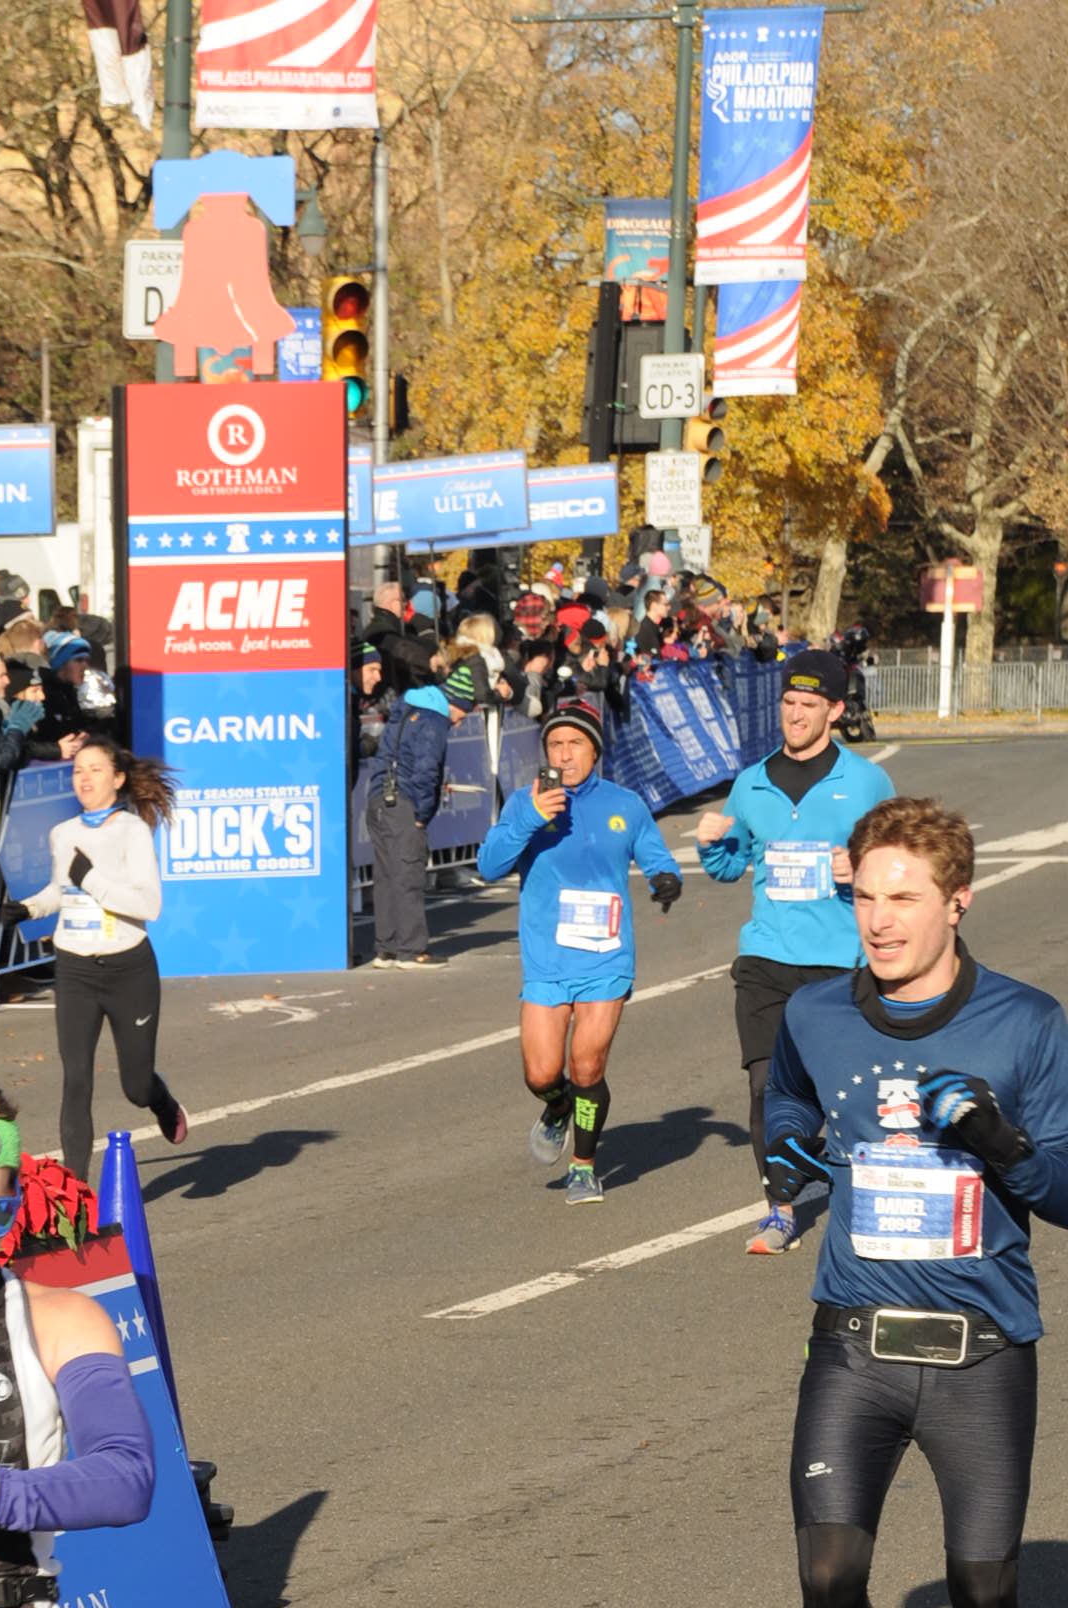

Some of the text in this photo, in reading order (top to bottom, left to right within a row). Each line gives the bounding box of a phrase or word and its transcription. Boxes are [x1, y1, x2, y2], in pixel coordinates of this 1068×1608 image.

[712, 62, 814, 86] PHILADELPHIA
[733, 86, 813, 109] MARATHON
[139, 264, 182, 276] LOCAT
[645, 383, 695, 409] CD-3
[227, 424, 249, 446] R
[176, 467, 297, 487] ROTHMAN
[651, 480, 697, 493] CLOSED
[434, 490, 504, 513] ULTRA
[167, 578, 308, 631] ACME
[164, 714, 316, 744] GARMIN
[176, 784, 320, 801] ERY SEASON STARTS AT
[170, 799, 313, 859] DICK'S
[172, 859, 252, 874] SPORTING
[874, 1197, 927, 1216] DANIEL
[961, 1214, 973, 1247] MAROON
